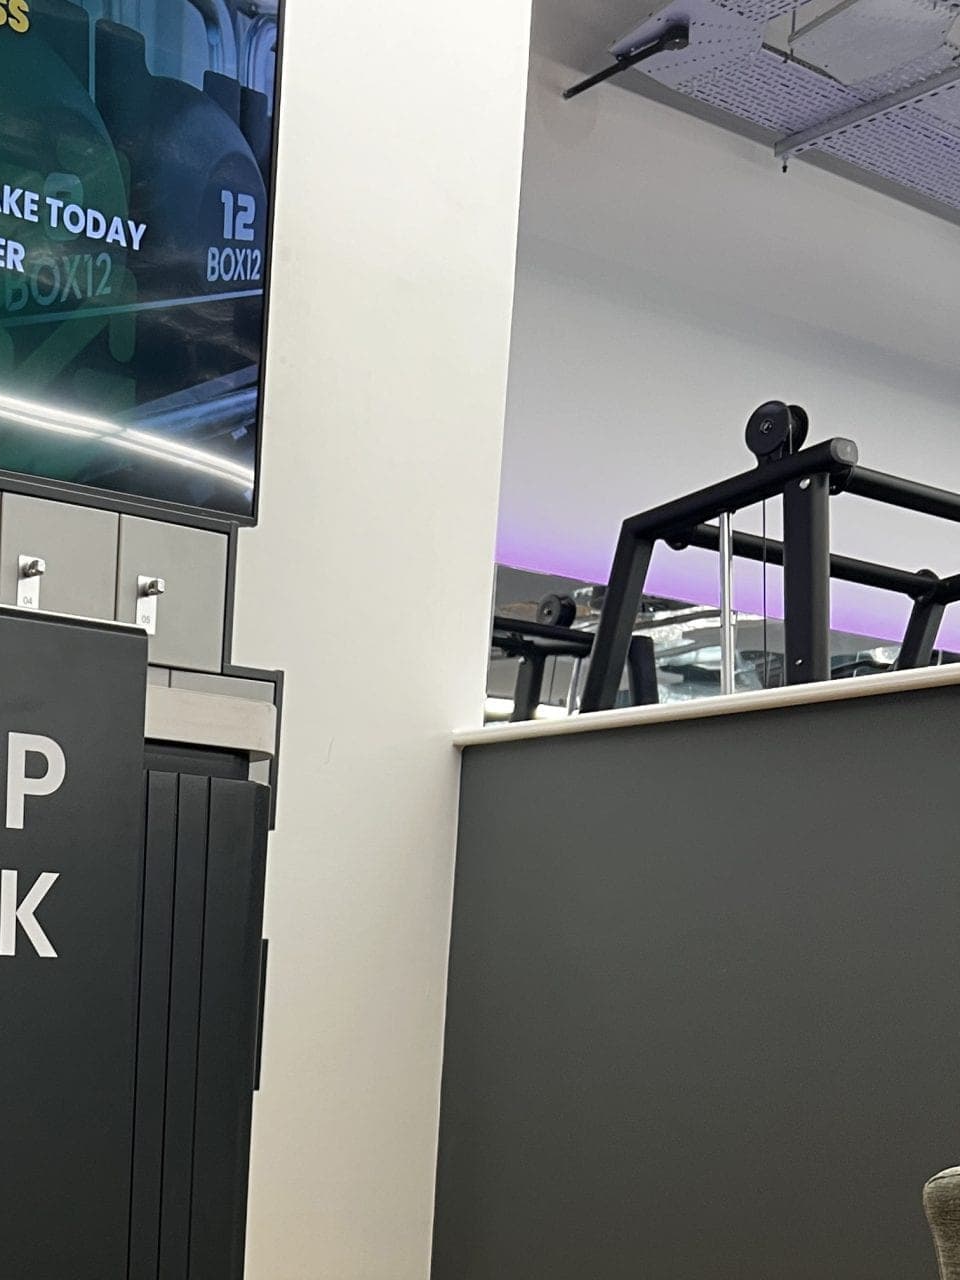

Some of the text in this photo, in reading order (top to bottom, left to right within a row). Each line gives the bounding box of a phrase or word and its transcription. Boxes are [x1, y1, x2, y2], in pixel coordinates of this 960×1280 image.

[46, 196, 148, 251] TODAY
[220, 189, 257, 242] 12
[4, 251, 113, 312] BOX12
[206, 246, 262, 283] BOX12
[22, 595, 33, 606] 04
[141, 615, 151, 625] 05
